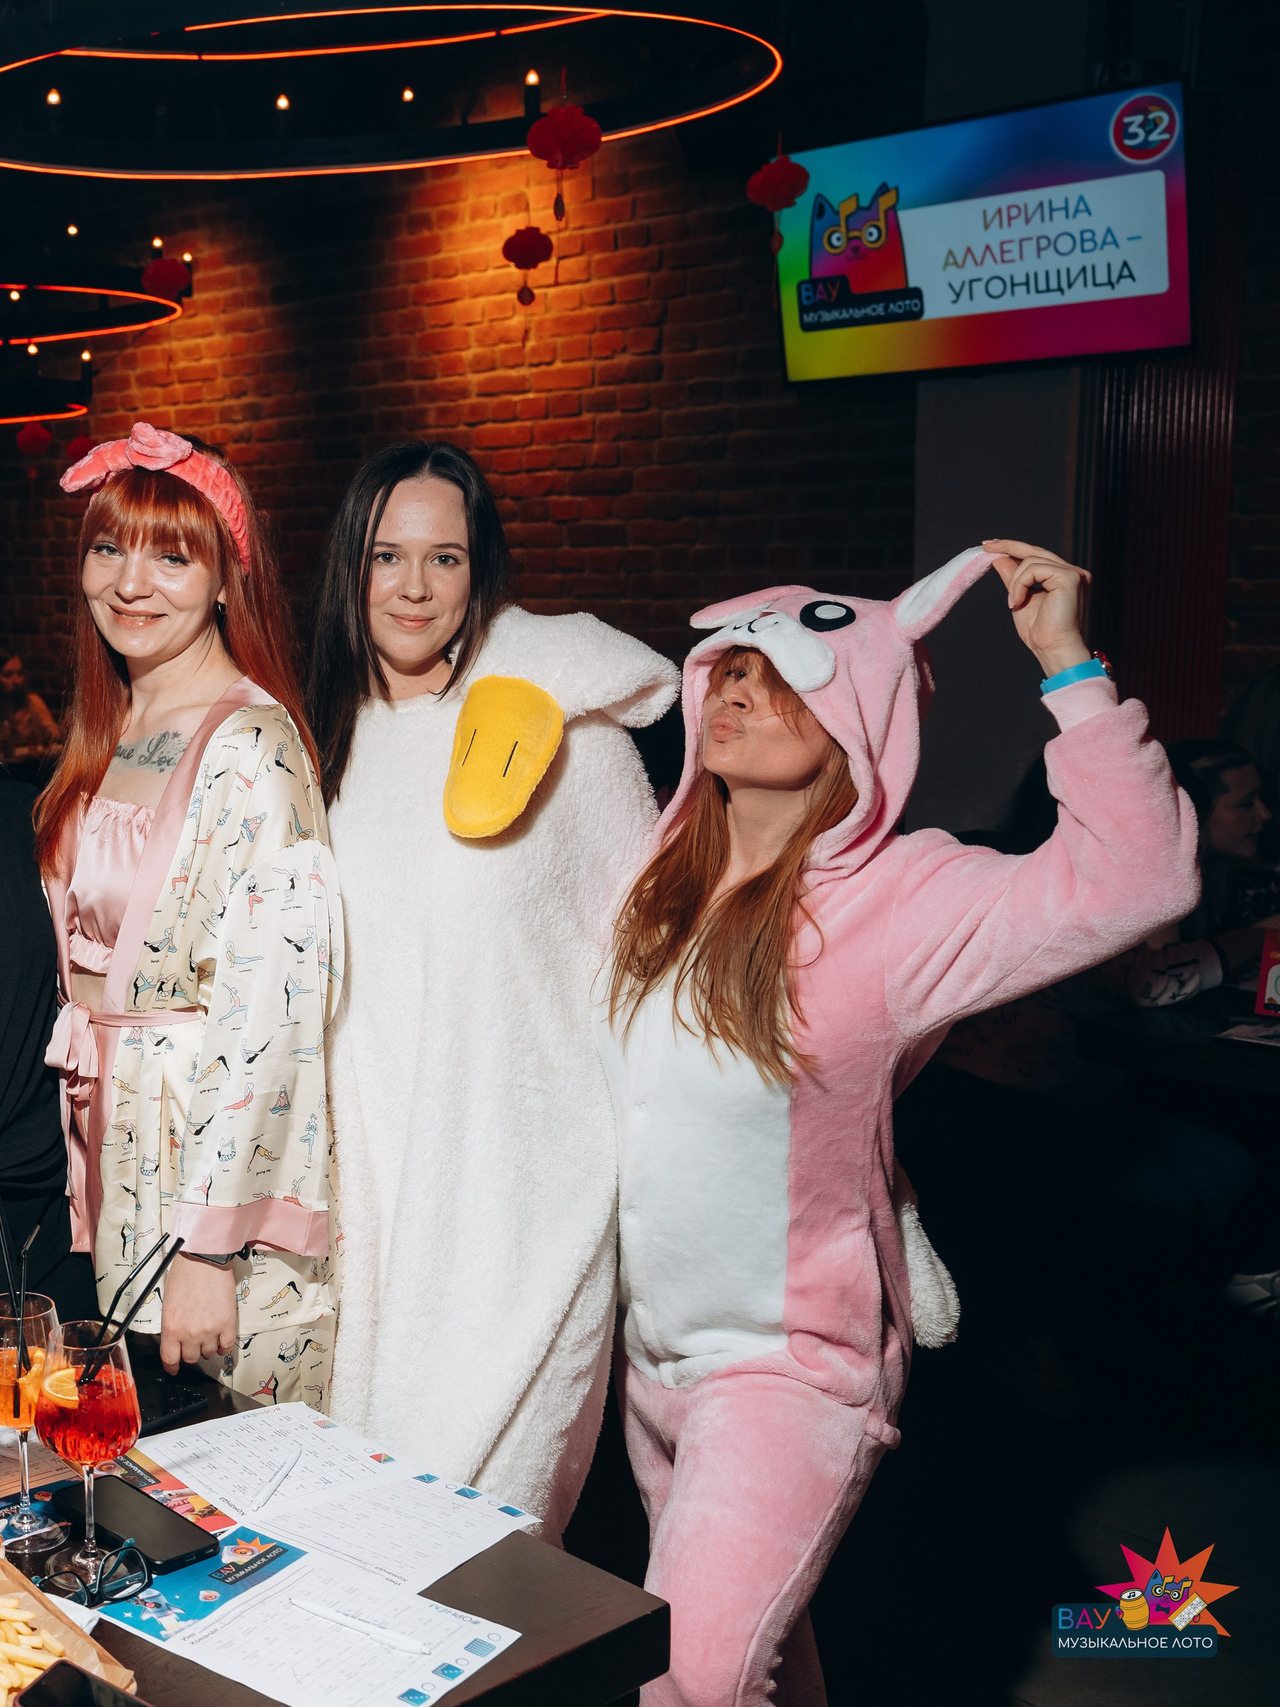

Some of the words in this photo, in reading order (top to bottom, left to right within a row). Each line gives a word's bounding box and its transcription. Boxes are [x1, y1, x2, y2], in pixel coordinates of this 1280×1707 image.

[1122, 110, 1171, 147] 32
[983, 194, 1092, 231] ИРИНА
[942, 227, 1120, 271] АЛЛЕГРОВА
[800, 279, 841, 307] ВАУ
[947, 260, 1137, 304] УГОНЩИЦА
[803, 302, 886, 323] МУЗЫКАЛЬНОЕ
[887, 298, 921, 313] ЛОТО
[211, 1563, 236, 1579] ВАУ
